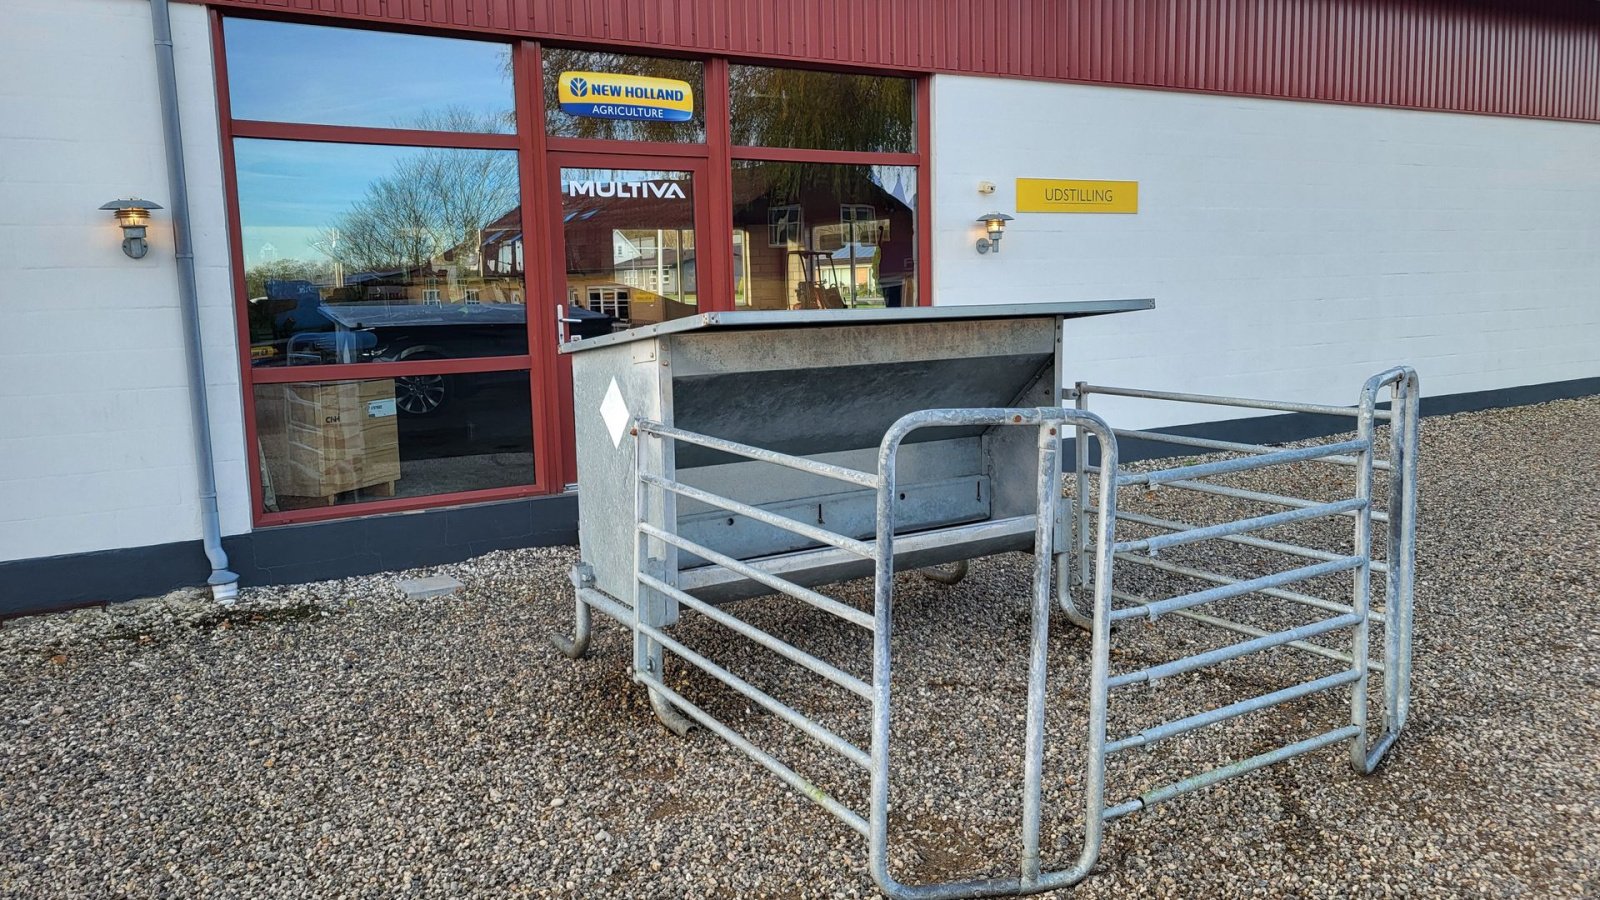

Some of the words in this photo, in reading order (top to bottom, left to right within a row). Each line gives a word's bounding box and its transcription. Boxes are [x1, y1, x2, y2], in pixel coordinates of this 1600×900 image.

[591, 84, 622, 97] NEW
[625, 86, 684, 102] HOLLAND
[592, 105, 664, 118] AGRICULTURE
[569, 180, 686, 199] MULTIVA
[1045, 188, 1113, 202] UDSTILLING
